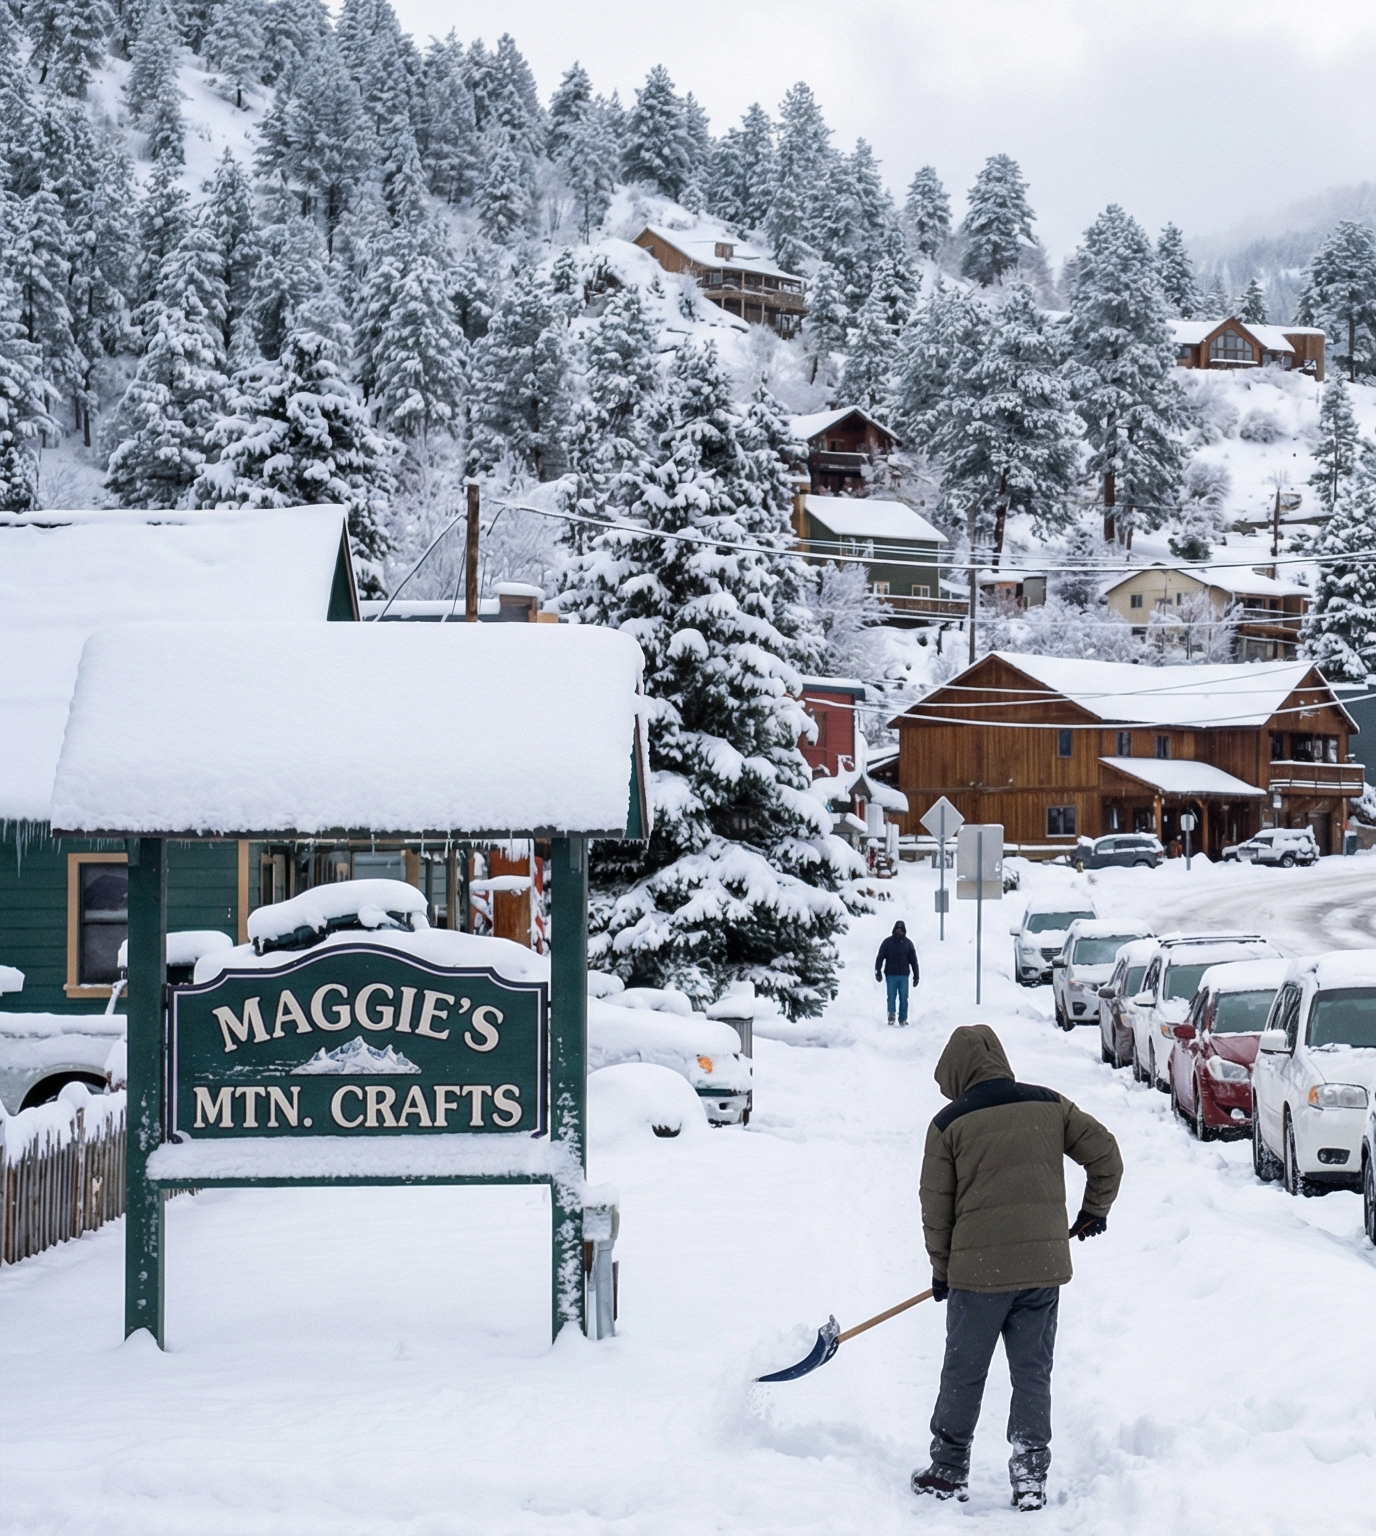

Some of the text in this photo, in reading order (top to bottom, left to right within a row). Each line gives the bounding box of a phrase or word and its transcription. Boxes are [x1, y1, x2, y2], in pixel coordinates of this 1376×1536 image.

[212, 983, 504, 1053] MAGGIE'S
[193, 1083, 523, 1129] MTN. CRAFTS
